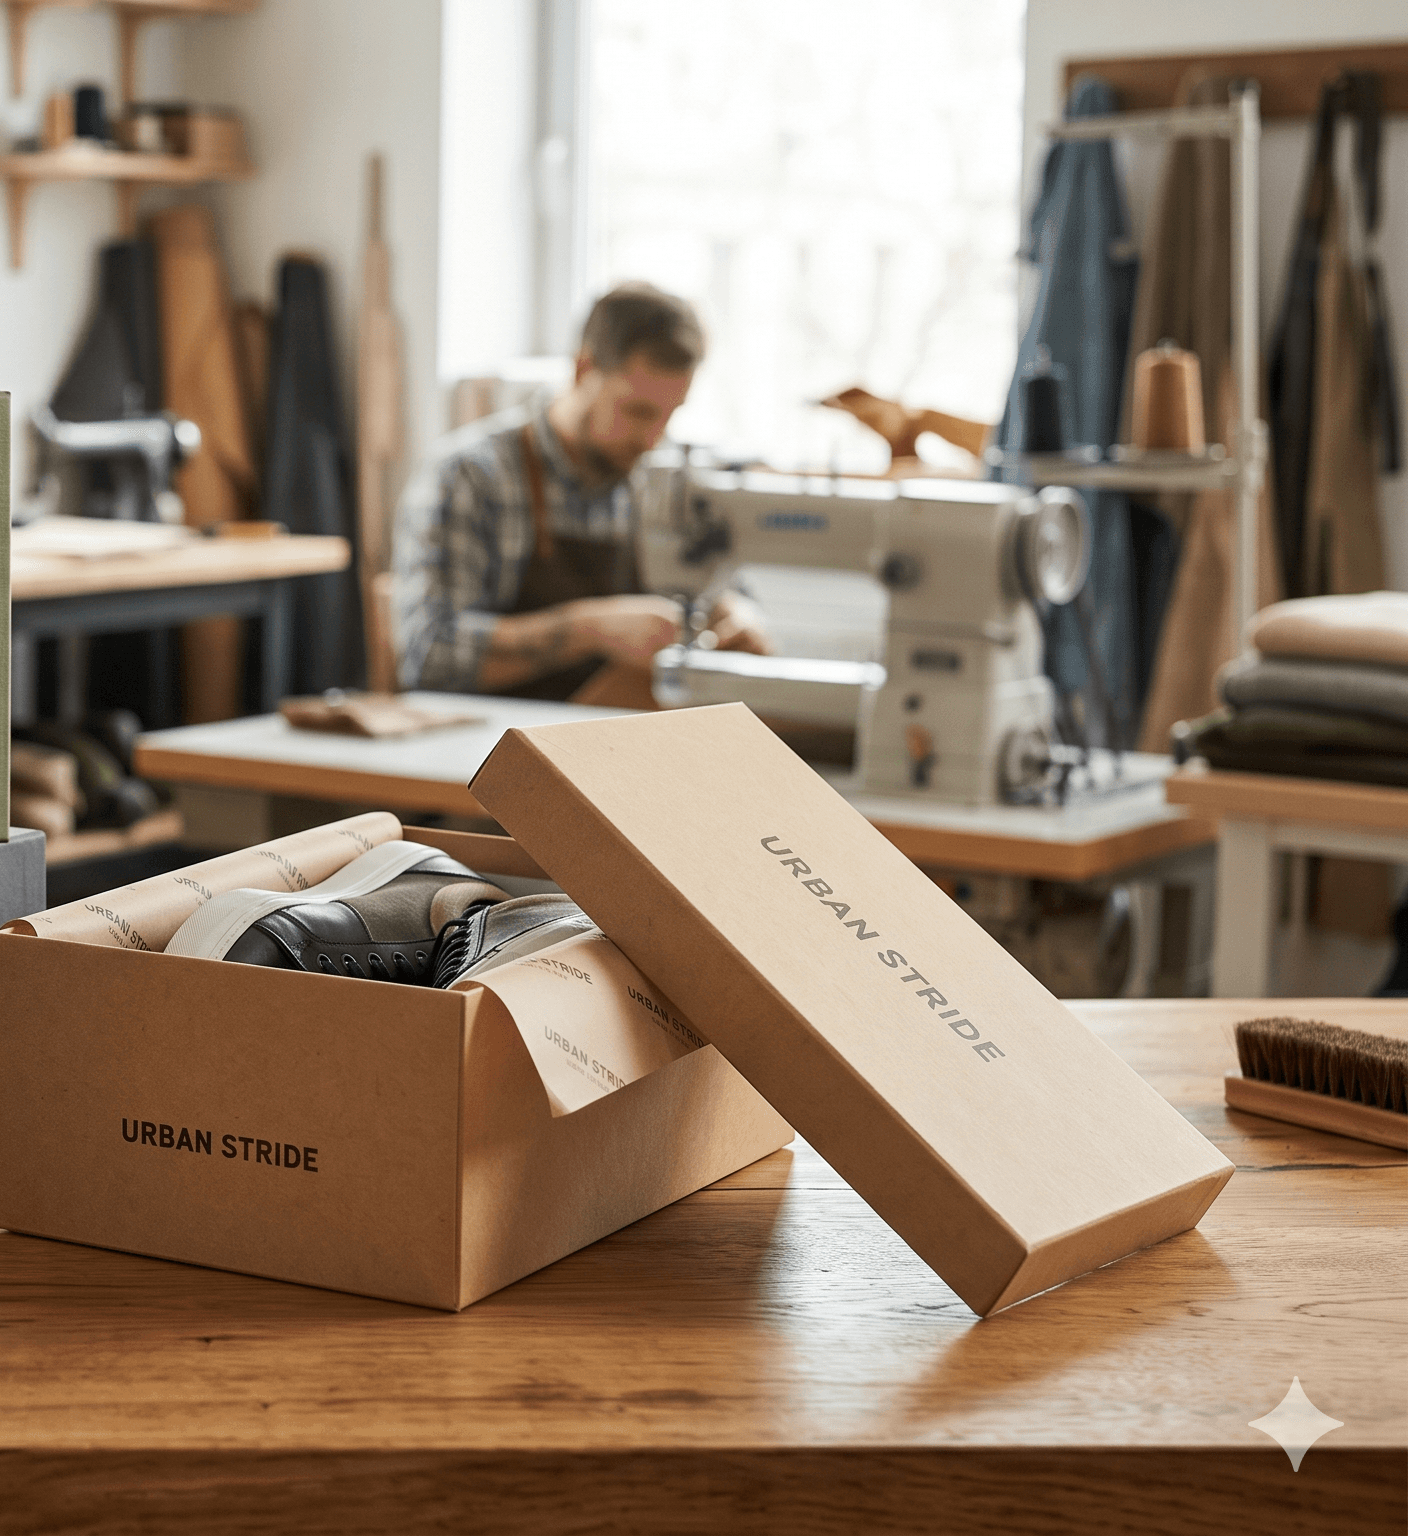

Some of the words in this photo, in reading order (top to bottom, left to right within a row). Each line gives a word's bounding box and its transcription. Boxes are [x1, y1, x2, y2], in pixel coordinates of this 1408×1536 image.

[760, 835, 880, 941] URBAN
[877, 949, 1006, 1063] STRIDE
[627, 986, 669, 1024] URBAN
[545, 1026, 588, 1066] URBAN
[122, 1118, 212, 1155] URBAN
[221, 1134, 319, 1173] STRIDE
